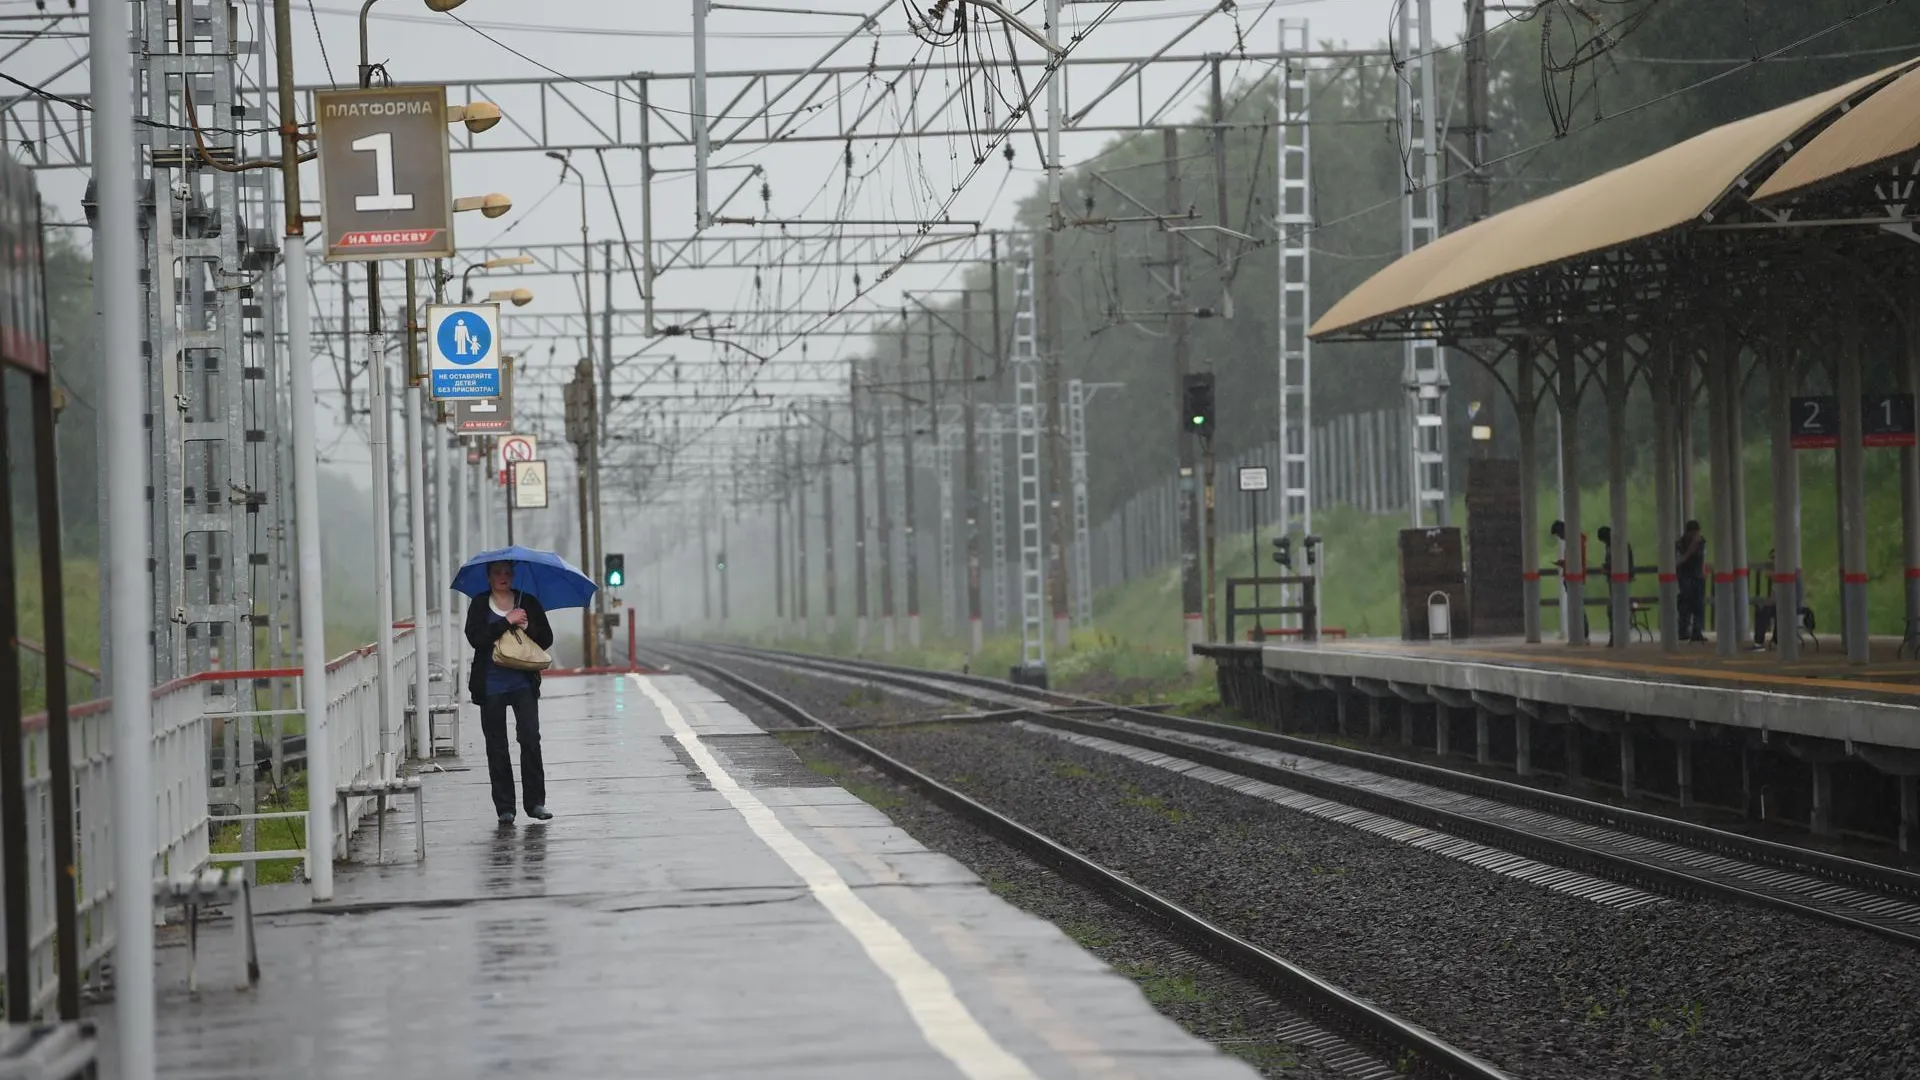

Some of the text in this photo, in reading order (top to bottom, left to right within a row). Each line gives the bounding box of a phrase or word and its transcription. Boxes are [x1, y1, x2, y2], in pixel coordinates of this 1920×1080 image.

[326, 101, 433, 117] ПЛАТФОРМА
[351, 132, 415, 212] 1
[348, 232, 428, 245] НА МОСКВУ
[449, 372, 492, 380] ОСТАВЛЯЙТЕ
[454, 379, 477, 387] ДЕТЕЙ
[1803, 401, 1822, 428] 2
[1880, 399, 1892, 426] 1
